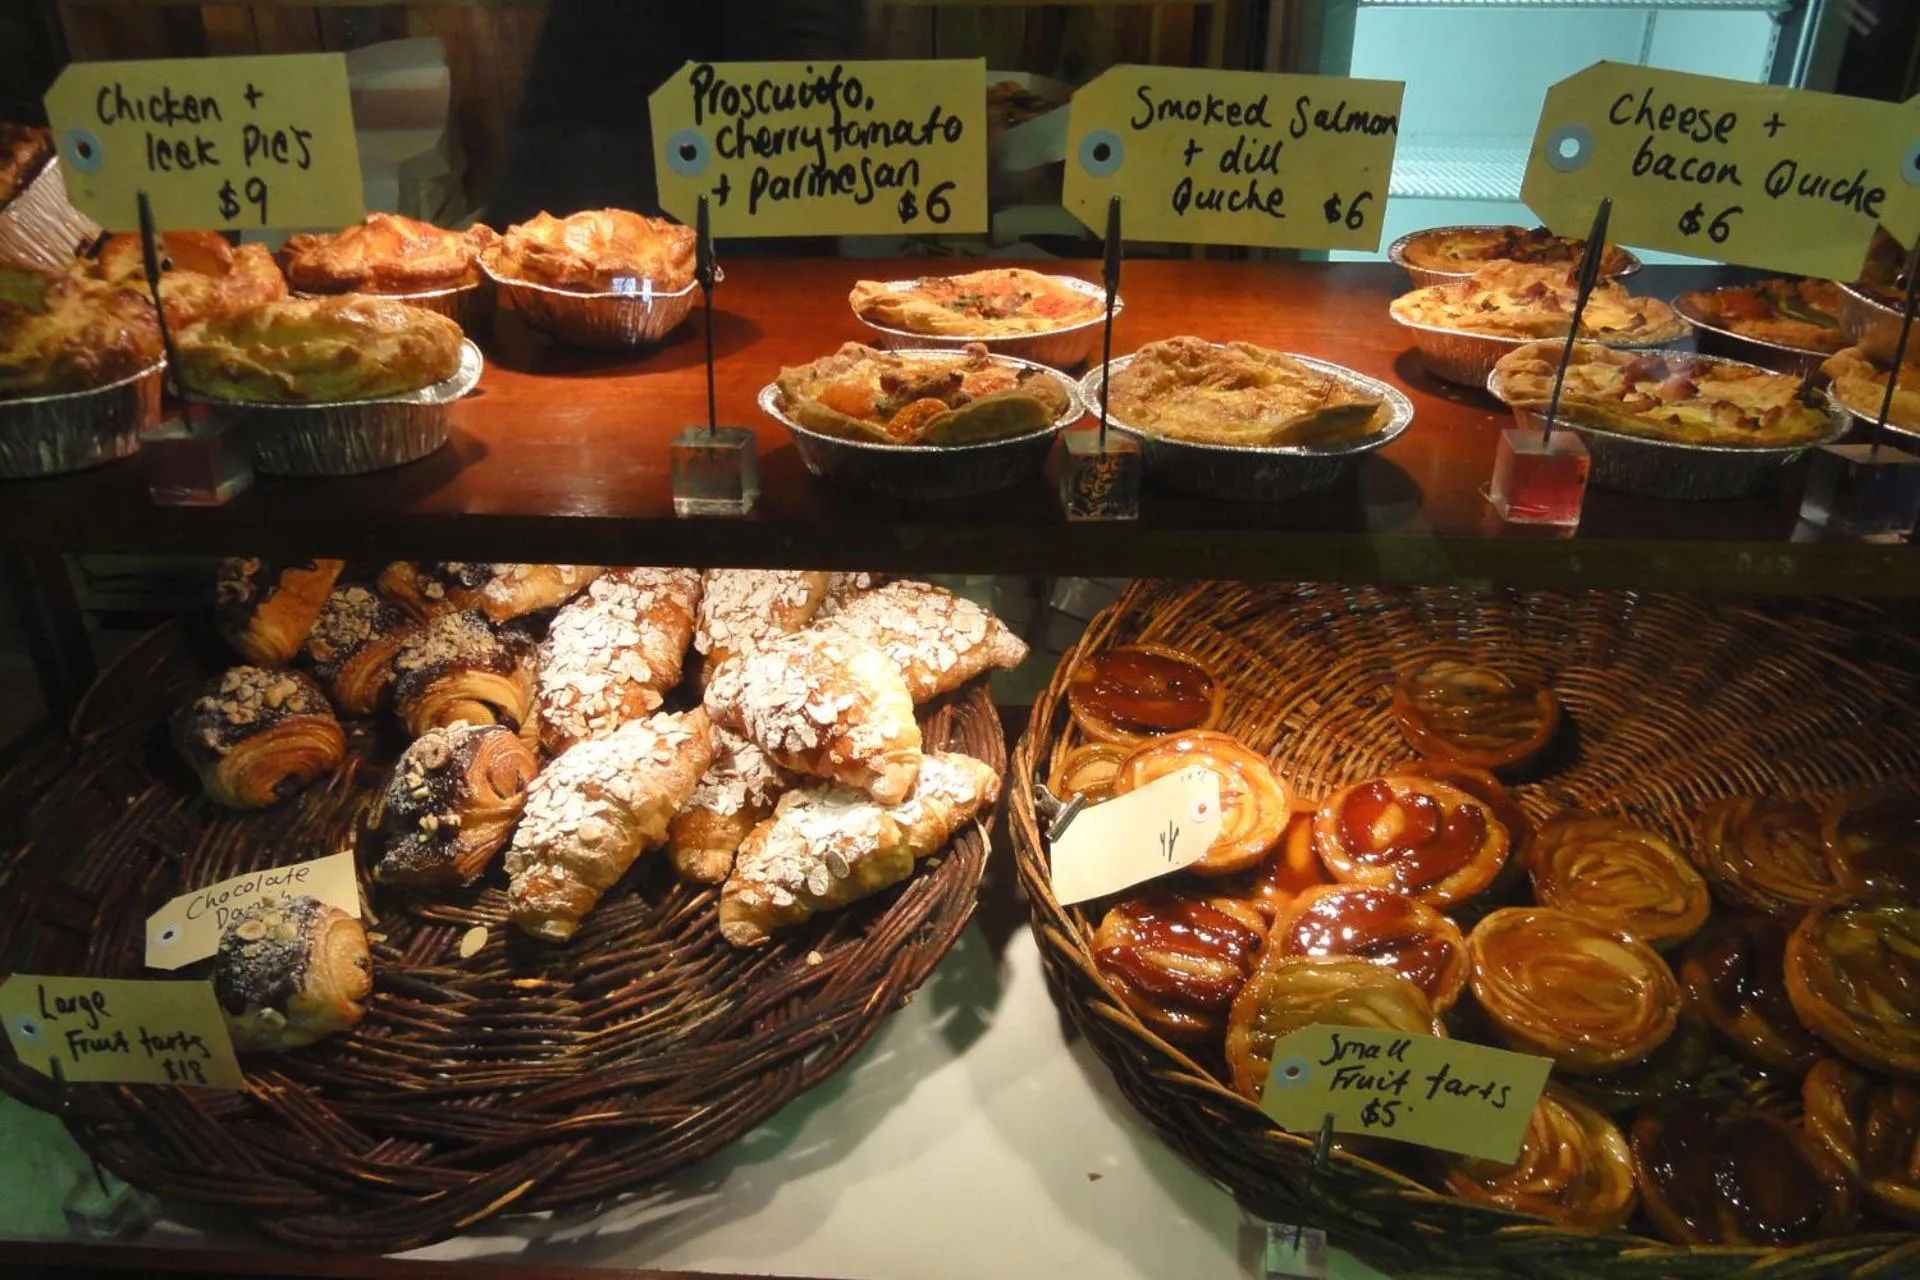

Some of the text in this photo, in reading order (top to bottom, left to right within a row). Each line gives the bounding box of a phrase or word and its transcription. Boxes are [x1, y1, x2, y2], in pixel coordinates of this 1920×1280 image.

[96, 83, 264, 125] Chicken +
[1130, 85, 1398, 139] Smoked Salmon
[1608, 87, 1786, 144] Cheese +
[145, 132, 220, 171] leek
[1184, 134, 1283, 175] + dill
[711, 173, 731, 206] +
[1631, 135, 1886, 219] bacon Quiche
[217, 177, 267, 225] $9
[897, 181, 956, 224] $6
[1171, 176, 1373, 230] Quiche $6
[1677, 201, 1743, 243] $6
[185, 866, 310, 921] Chocolate
[1319, 1033, 1412, 1066] Small
[1329, 1063, 1512, 1109] Fruit tarts
